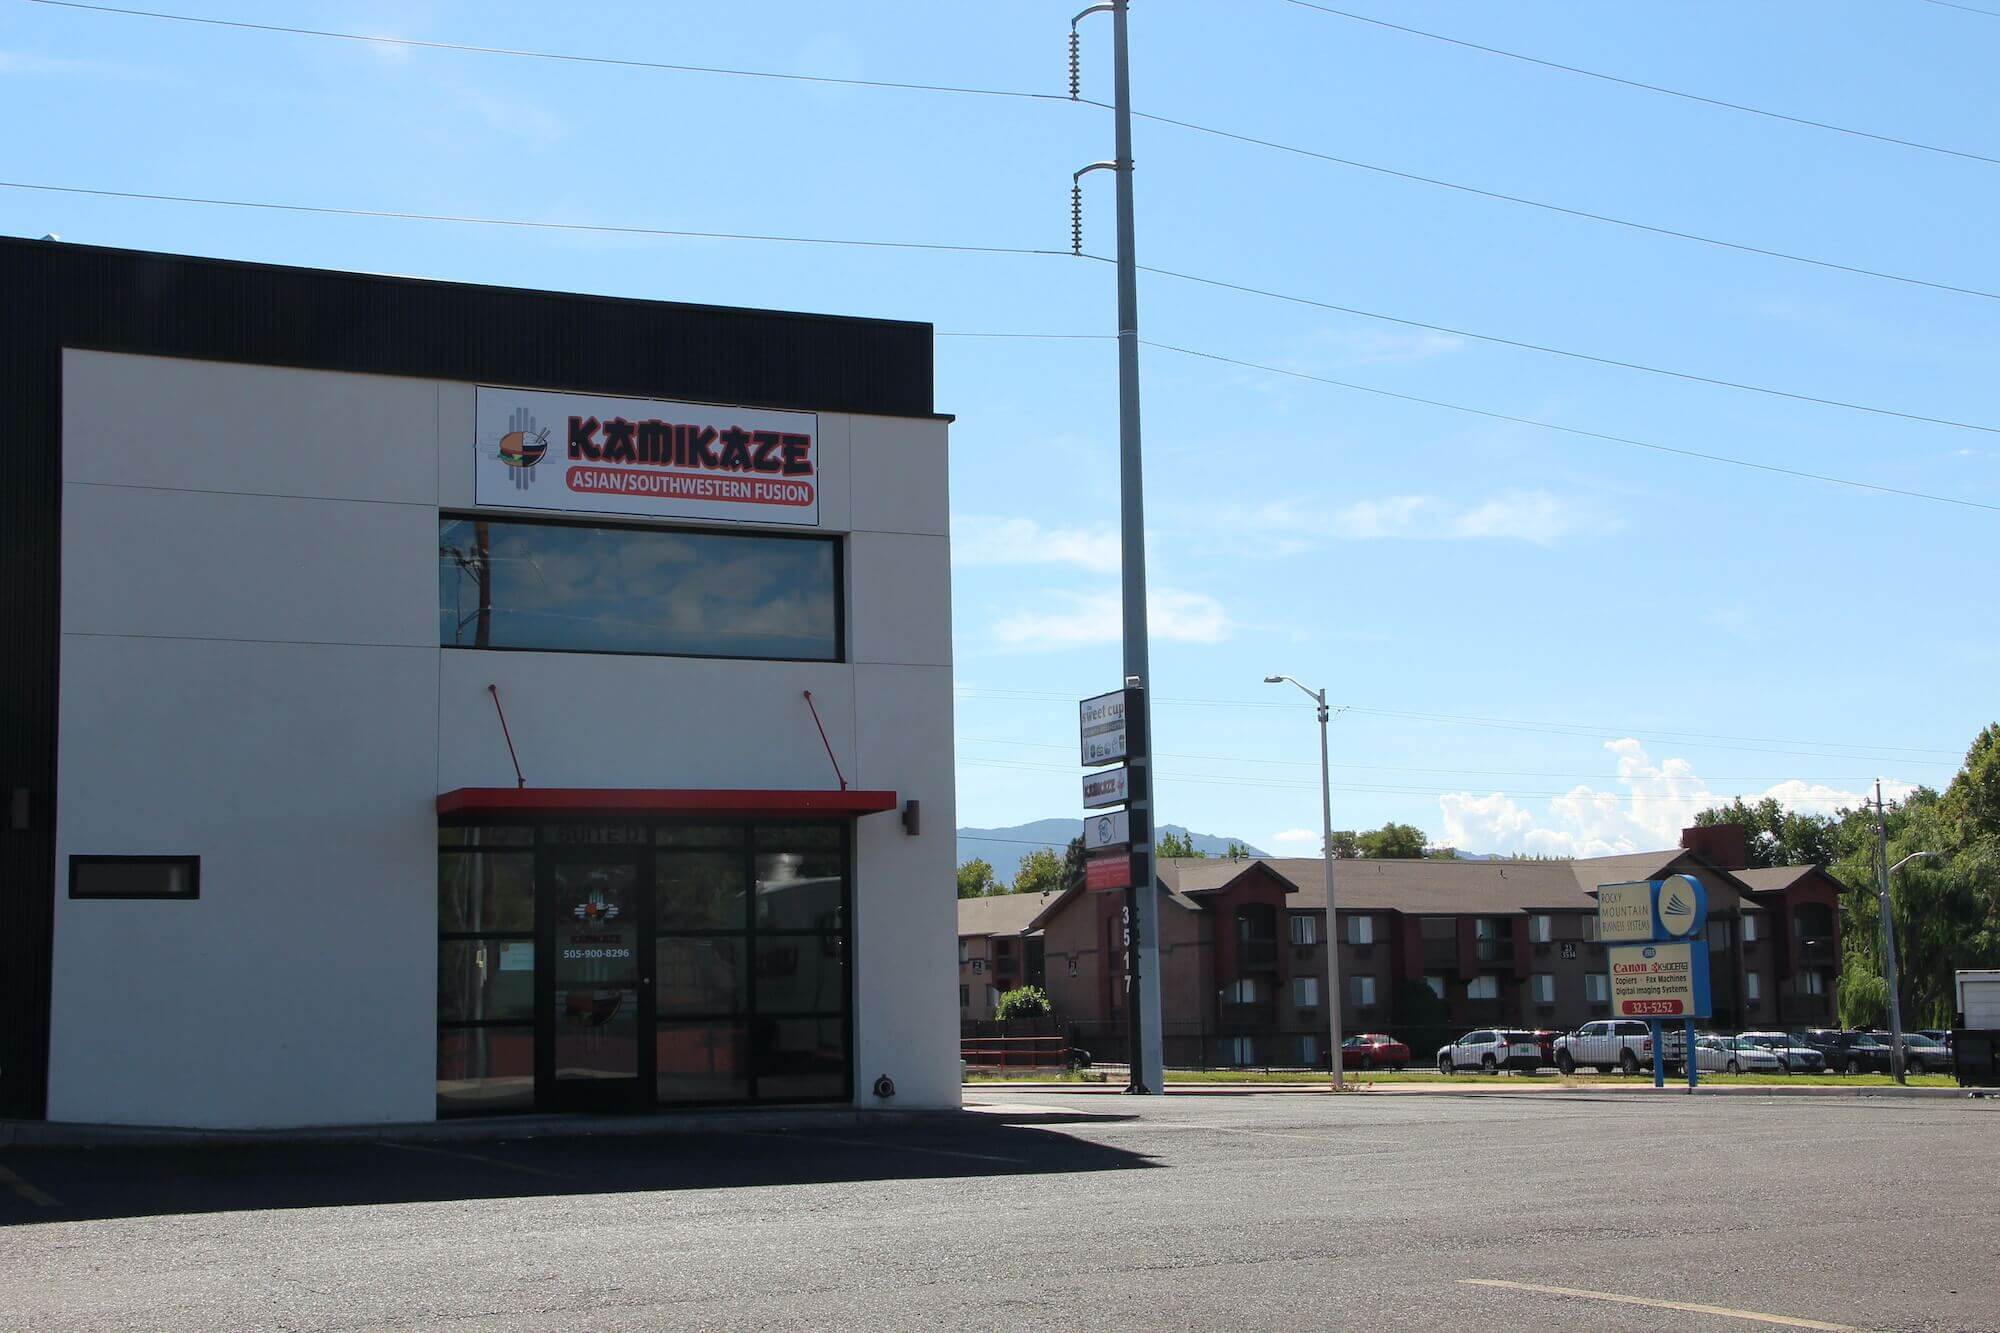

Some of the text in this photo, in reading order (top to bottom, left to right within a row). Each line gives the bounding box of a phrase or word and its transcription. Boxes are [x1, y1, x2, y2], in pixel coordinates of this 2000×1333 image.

[568, 416, 813, 476] KAMIKAZE
[573, 471, 809, 502] ASIAN/SOUTHWESTERN FUSION
[1108, 703, 1124, 719] cup
[1601, 893, 1621, 904] ROCKY
[1602, 905, 1648, 918] MOUNTAIN
[1627, 919, 1650, 931] SYSTEMS
[563, 949, 629, 959] 505-900-8296
[1613, 962, 1688, 973] Canon KYOCERA
[1616, 977, 1637, 986] Copiers
[1658, 974, 1687, 983] Machines
[1616, 985, 1688, 996] Digital Imaging Systems
[1632, 1002, 1673, 1013] 323-5252
